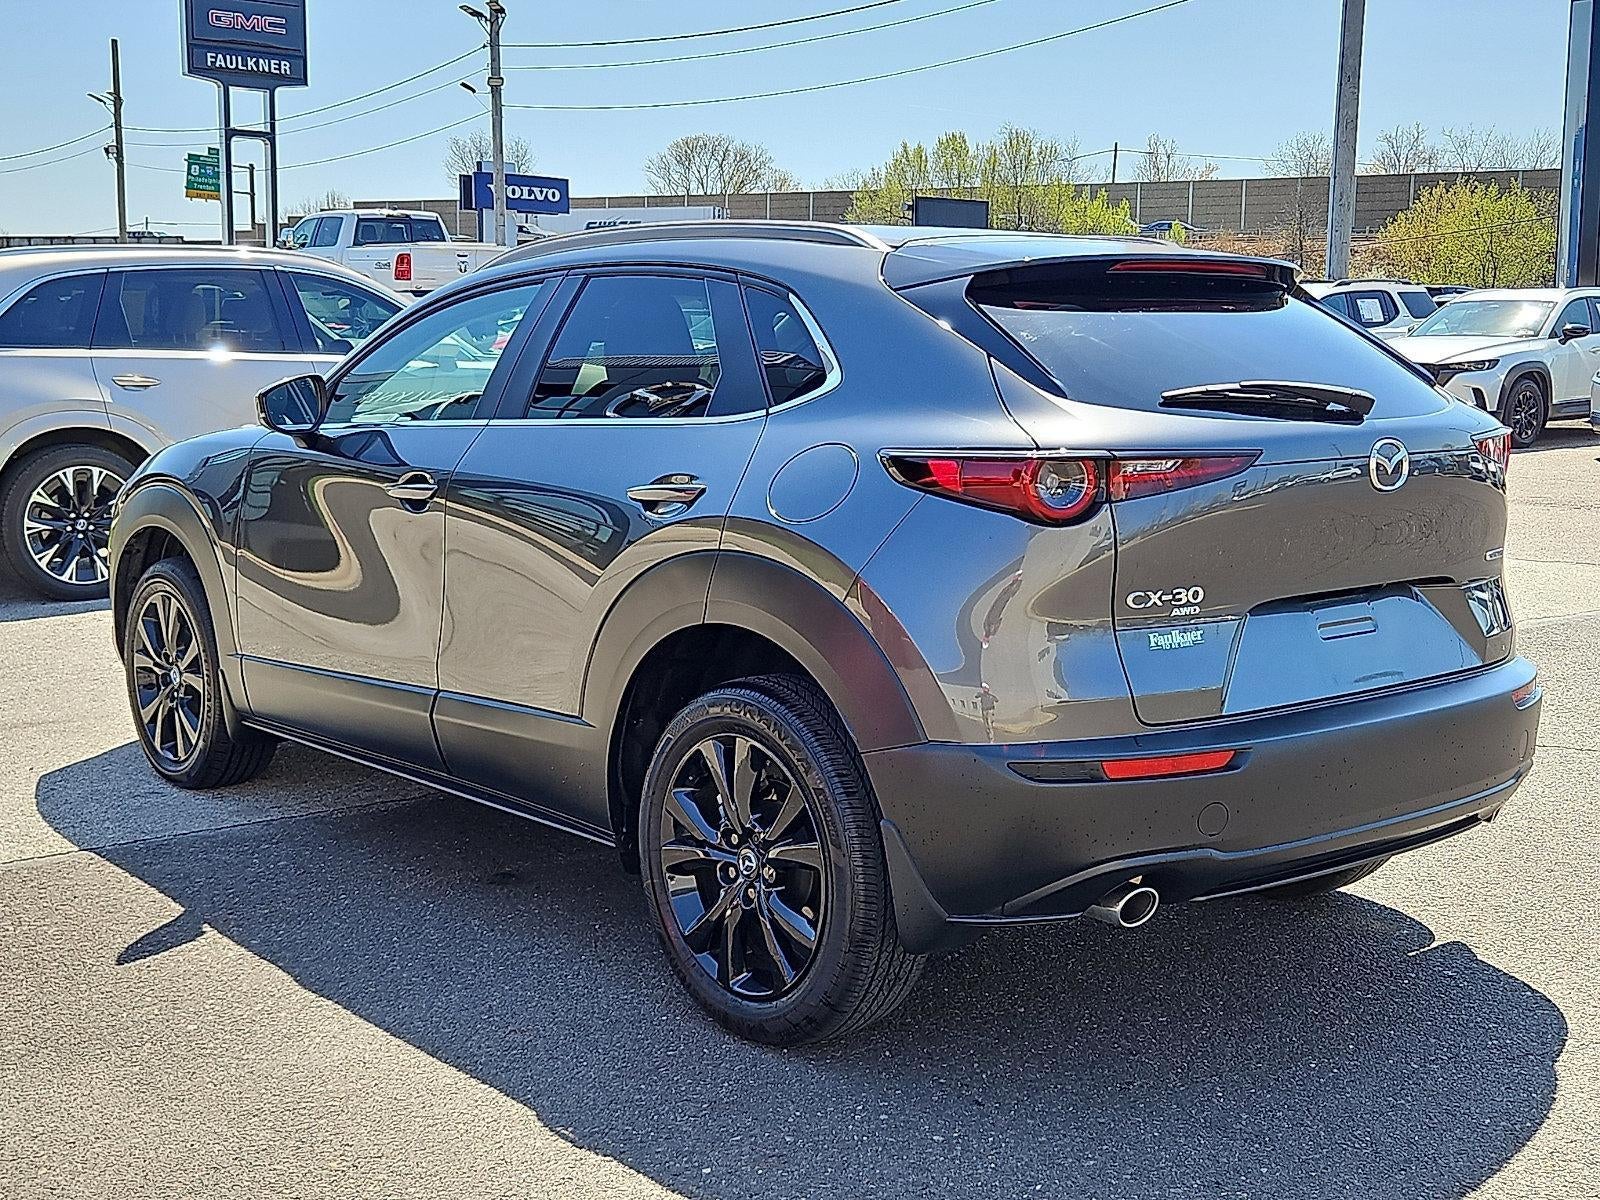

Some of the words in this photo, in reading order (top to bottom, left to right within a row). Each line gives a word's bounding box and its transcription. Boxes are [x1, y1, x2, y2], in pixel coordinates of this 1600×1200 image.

[208, 9, 287, 35] GMC
[206, 52, 292, 75] FAULKNER
[1125, 586, 1205, 609] CX-30
[1170, 605, 1200, 617] AWD
[1148, 630, 1204, 647] Faulkner
